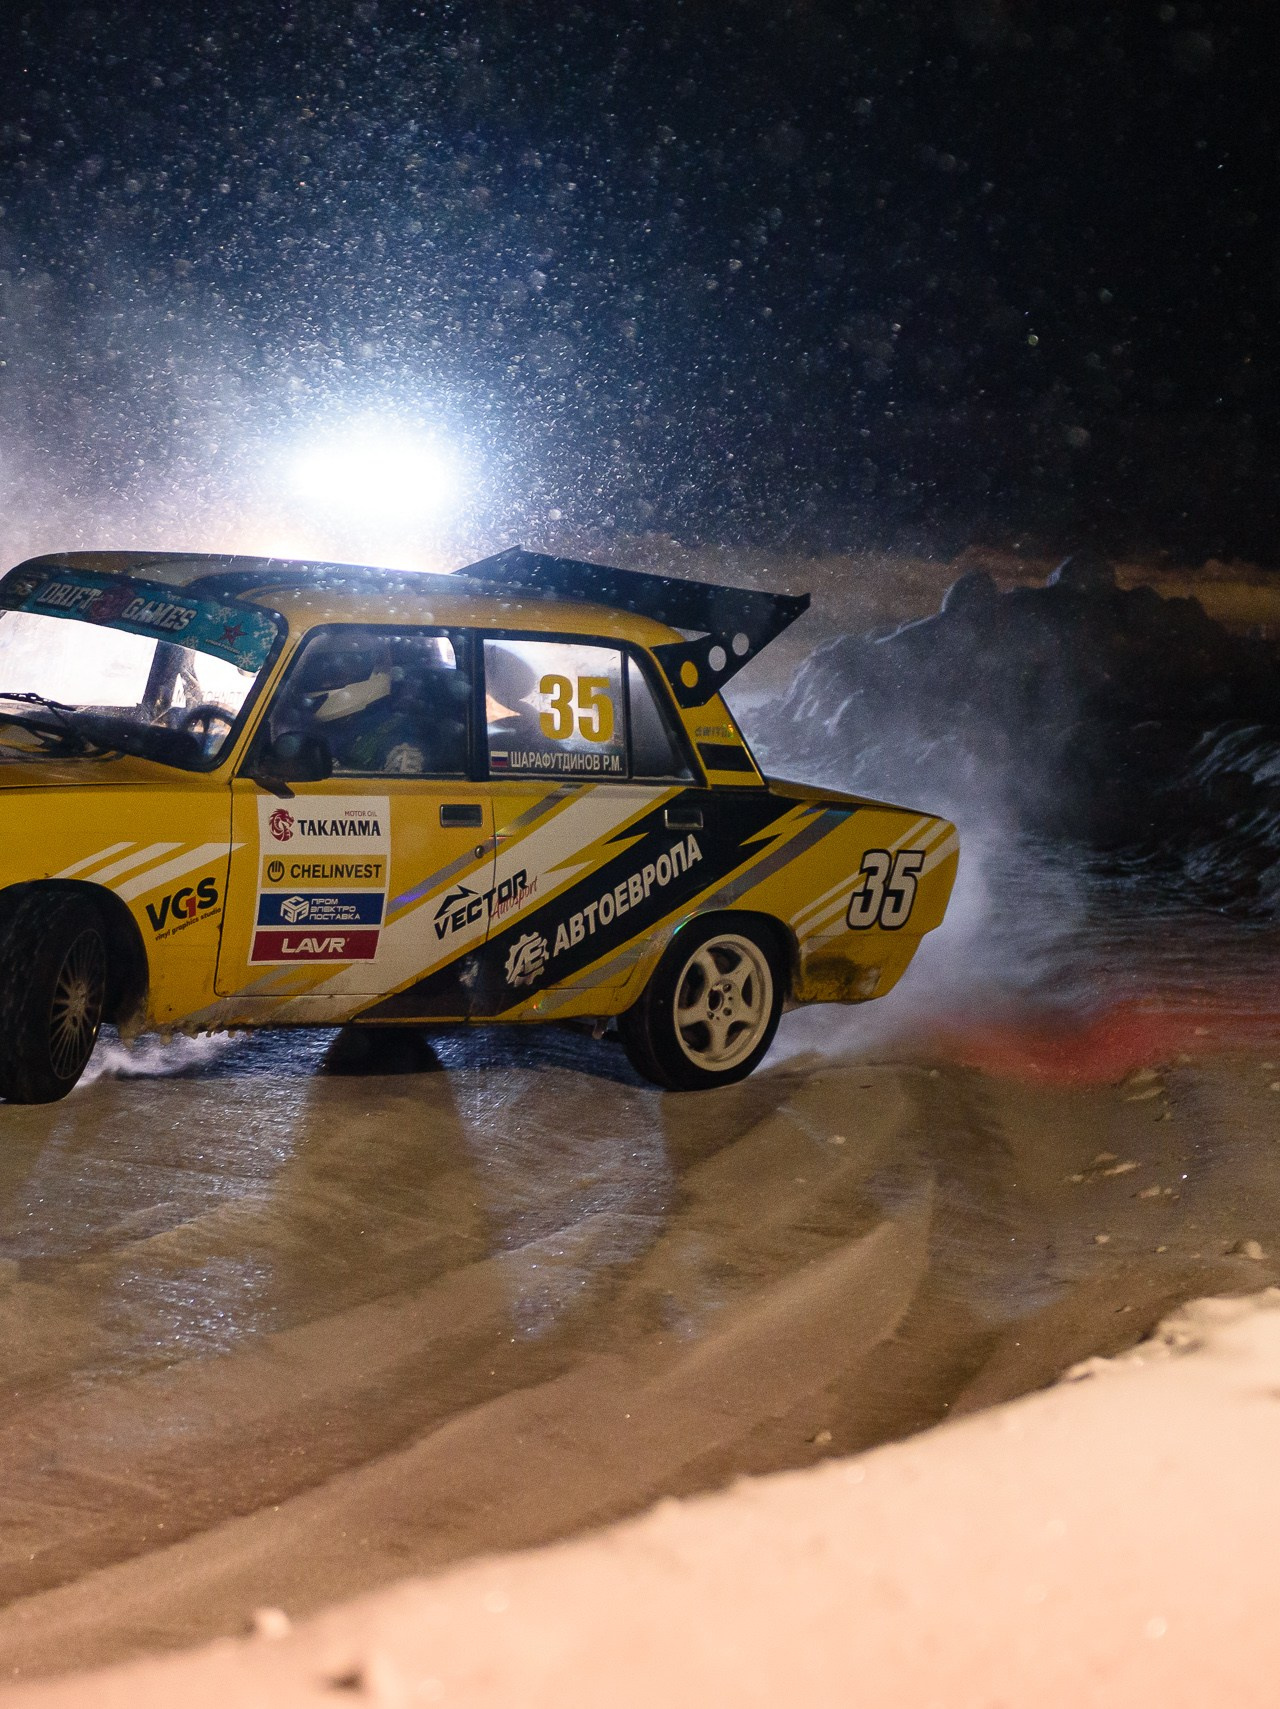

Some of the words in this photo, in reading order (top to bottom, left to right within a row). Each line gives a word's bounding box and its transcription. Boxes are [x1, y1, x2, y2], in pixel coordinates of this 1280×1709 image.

[36, 583, 104, 610] DRIFT
[121, 597, 197, 631] GAMES
[539, 674, 615, 743] 35
[511, 751, 601, 772] ШАРАФУТДИНОВ
[603, 755, 623, 772] Р.М.
[297, 819, 382, 837] TAKAYAMA
[290, 864, 382, 878] CHELINVEST
[845, 848, 926, 931] 35
[309, 913, 361, 921] ПОСТАВКА
[434, 868, 529, 940] VECTOR
[490, 875, 538, 920] Autosport
[553, 833, 703, 957] АВТОЕВРОПА
[281, 937, 346, 954] LAVR
